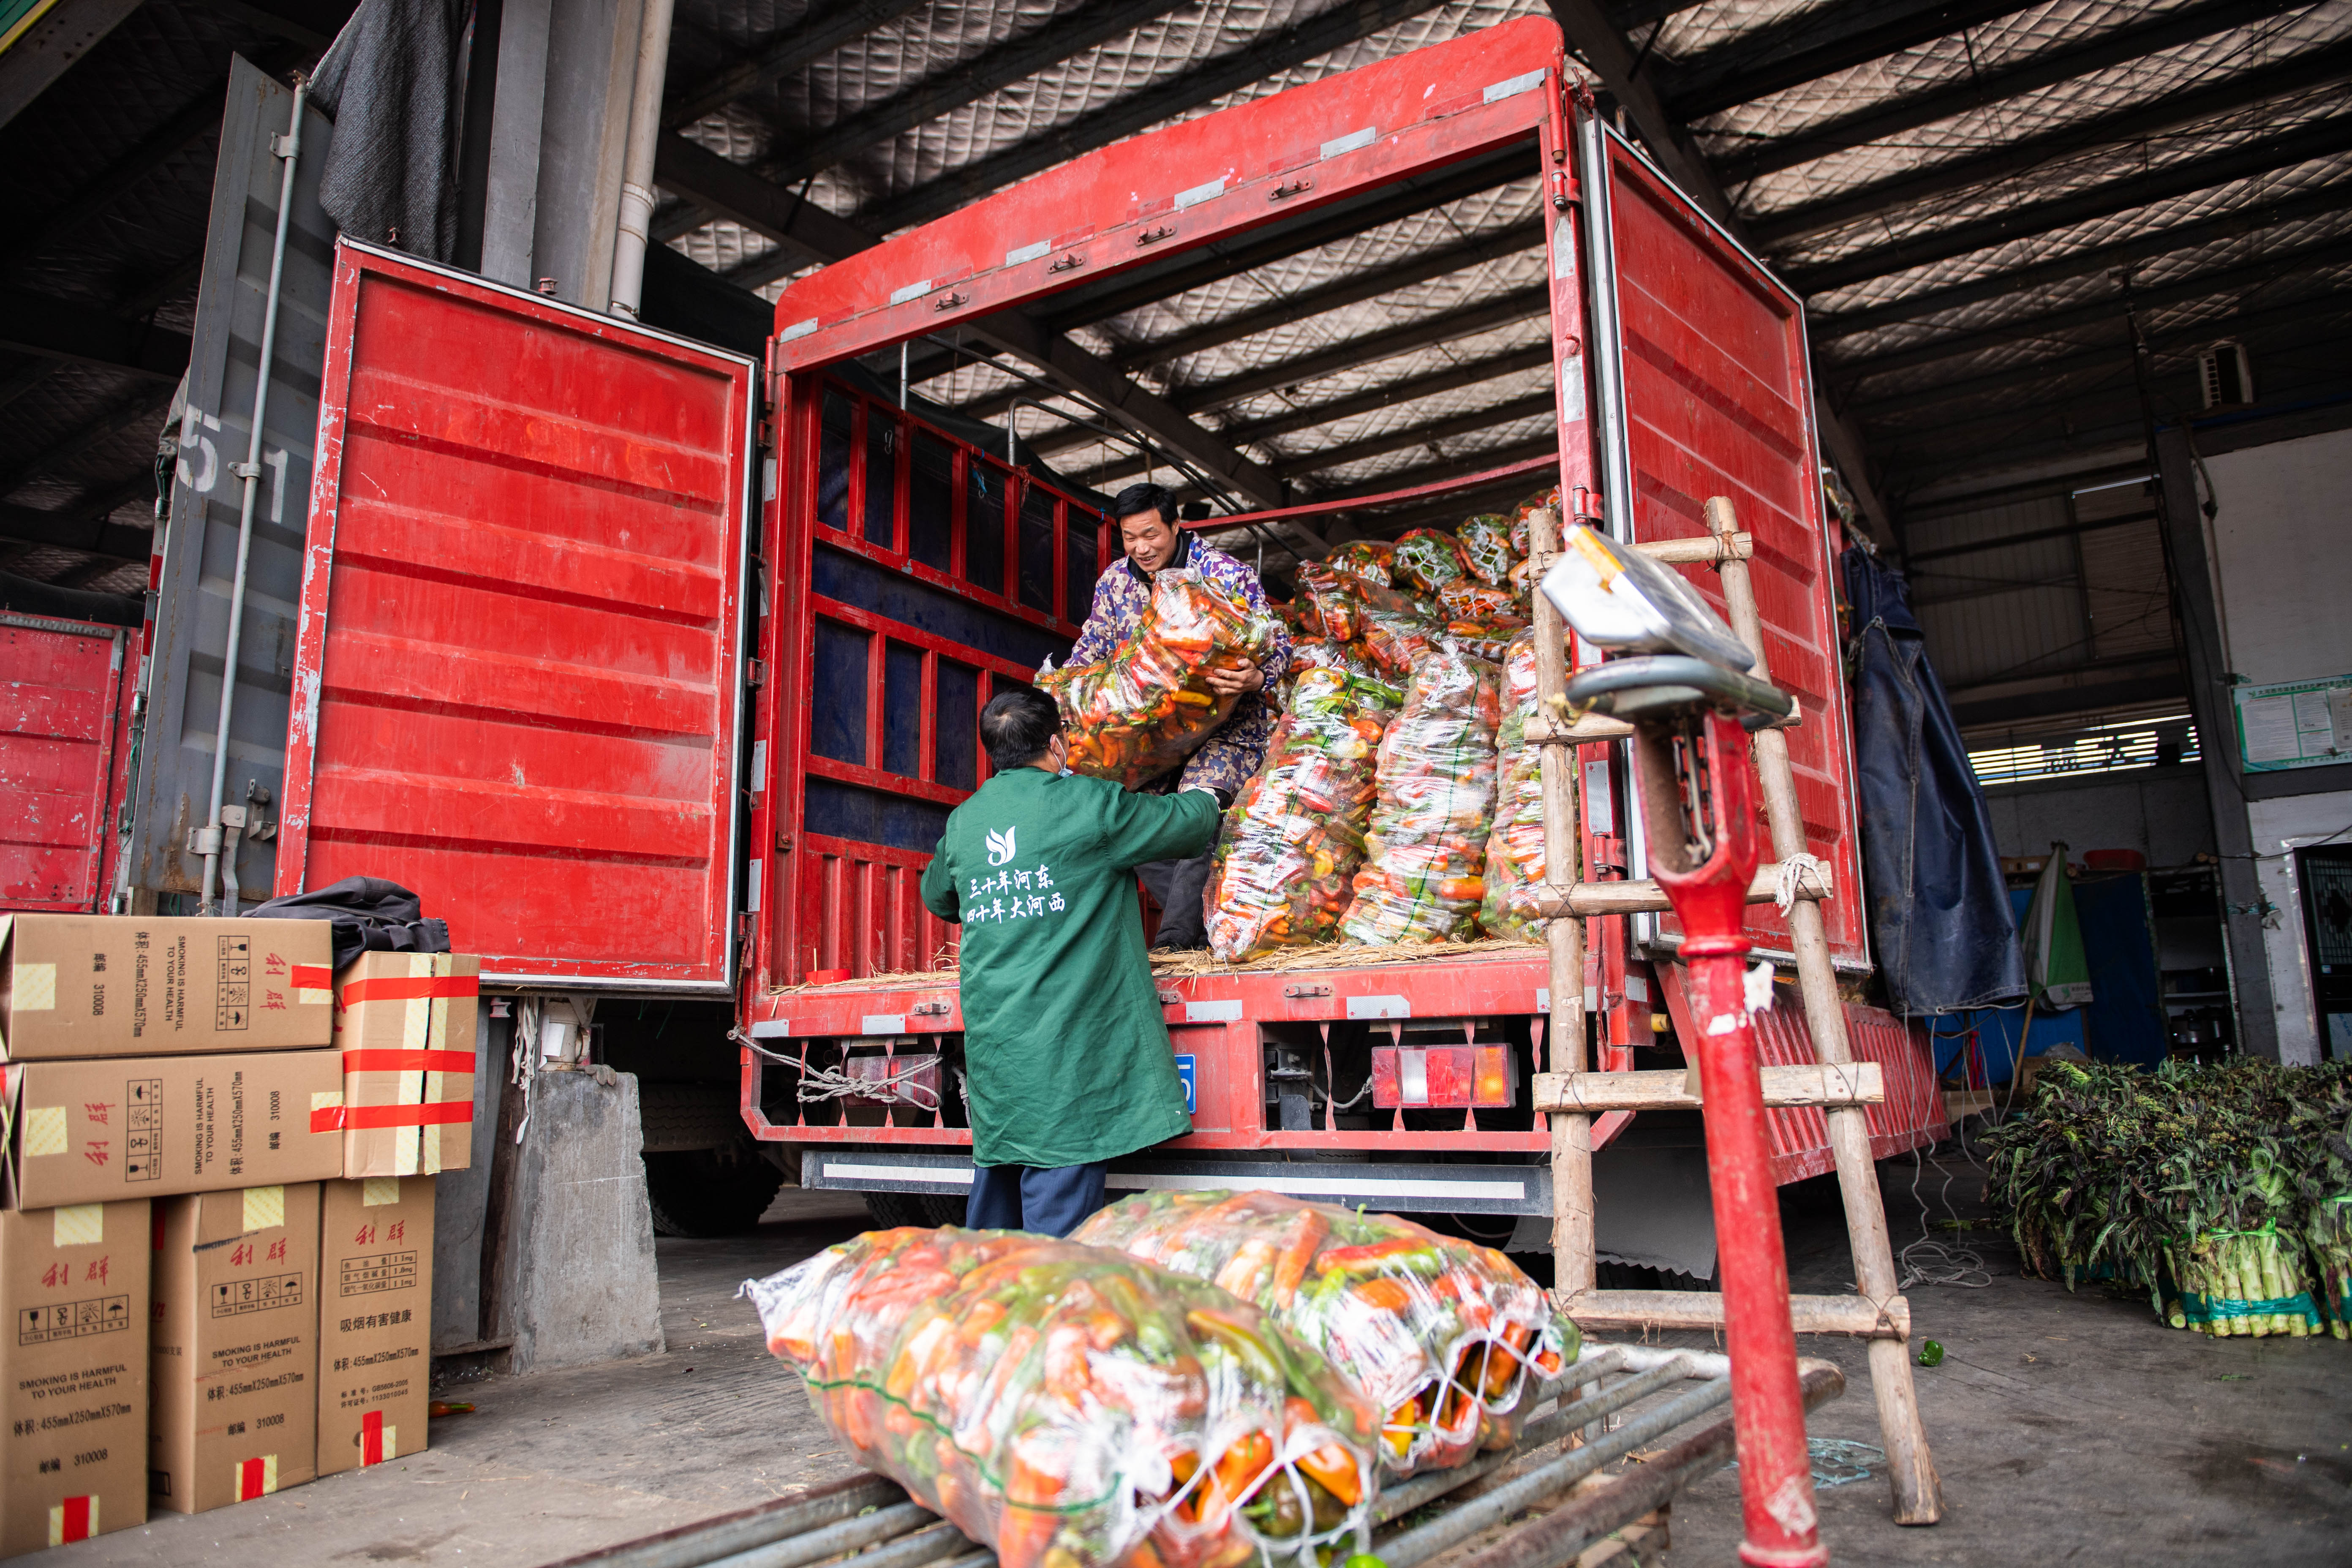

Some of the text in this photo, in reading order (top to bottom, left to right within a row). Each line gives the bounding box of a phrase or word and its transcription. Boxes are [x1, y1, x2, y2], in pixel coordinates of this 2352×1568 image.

[969, 864, 1054, 899] 三十年河东
[966, 892, 1066, 924] 四十年大河西
[168, 946, 175, 958] TO
[93, 953, 107, 1016] 邮编 310008
[177, 978, 185, 987] IS
[166, 988, 174, 1021] HEALTH
[175, 989, 184, 1031] HARMFUL
[196, 1123, 203, 1132] IS
[269, 1091, 280, 1150] 邮编 310008
[206, 1152, 212, 1163] TO
[340, 1309, 412, 1333] 吸烟有害健康
[212, 1345, 251, 1358] SMOKING
[263, 1336, 300, 1349] HARMFUL
[236, 1355, 259, 1365] YOUR
[261, 1348, 291, 1360] HEALTH
[19, 1364, 126, 1390] SMOKING IS HARMFUL
[32, 1377, 116, 1399] TO YOUR HEALTH
[228, 1414, 284, 1436] 邮编 310008
[74, 1448, 108, 1467] 310008
